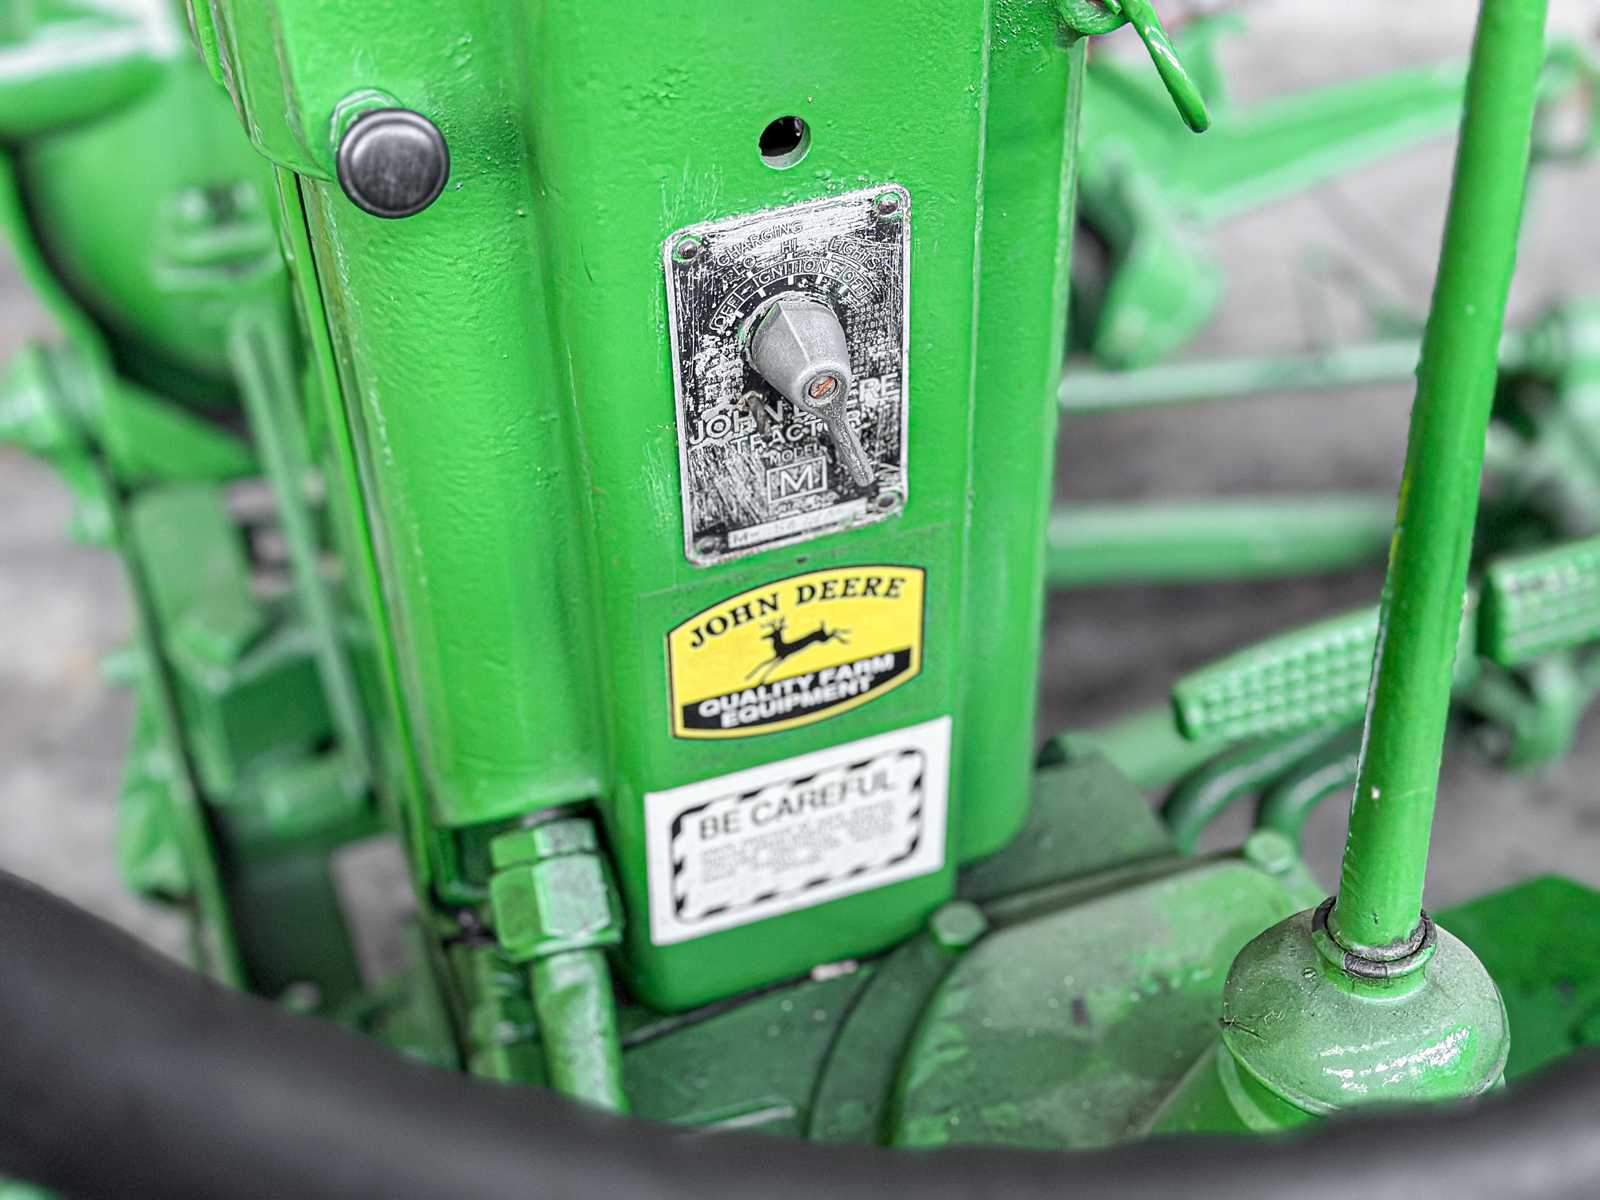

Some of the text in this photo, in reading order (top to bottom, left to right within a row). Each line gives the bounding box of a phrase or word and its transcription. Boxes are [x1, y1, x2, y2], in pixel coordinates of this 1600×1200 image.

[716, 220, 804, 267] CHARGING
[828, 236, 880, 271] LIGHTS
[752, 258, 831, 288] IGNITION
[769, 442, 823, 466] MODEL
[780, 464, 814, 497] M
[689, 576, 907, 648] JOHN DEERE
[698, 653, 896, 719] QUALITY FARM
[719, 675, 876, 729] EQUIPMENT
[699, 767, 897, 841] BE CAREFUL
